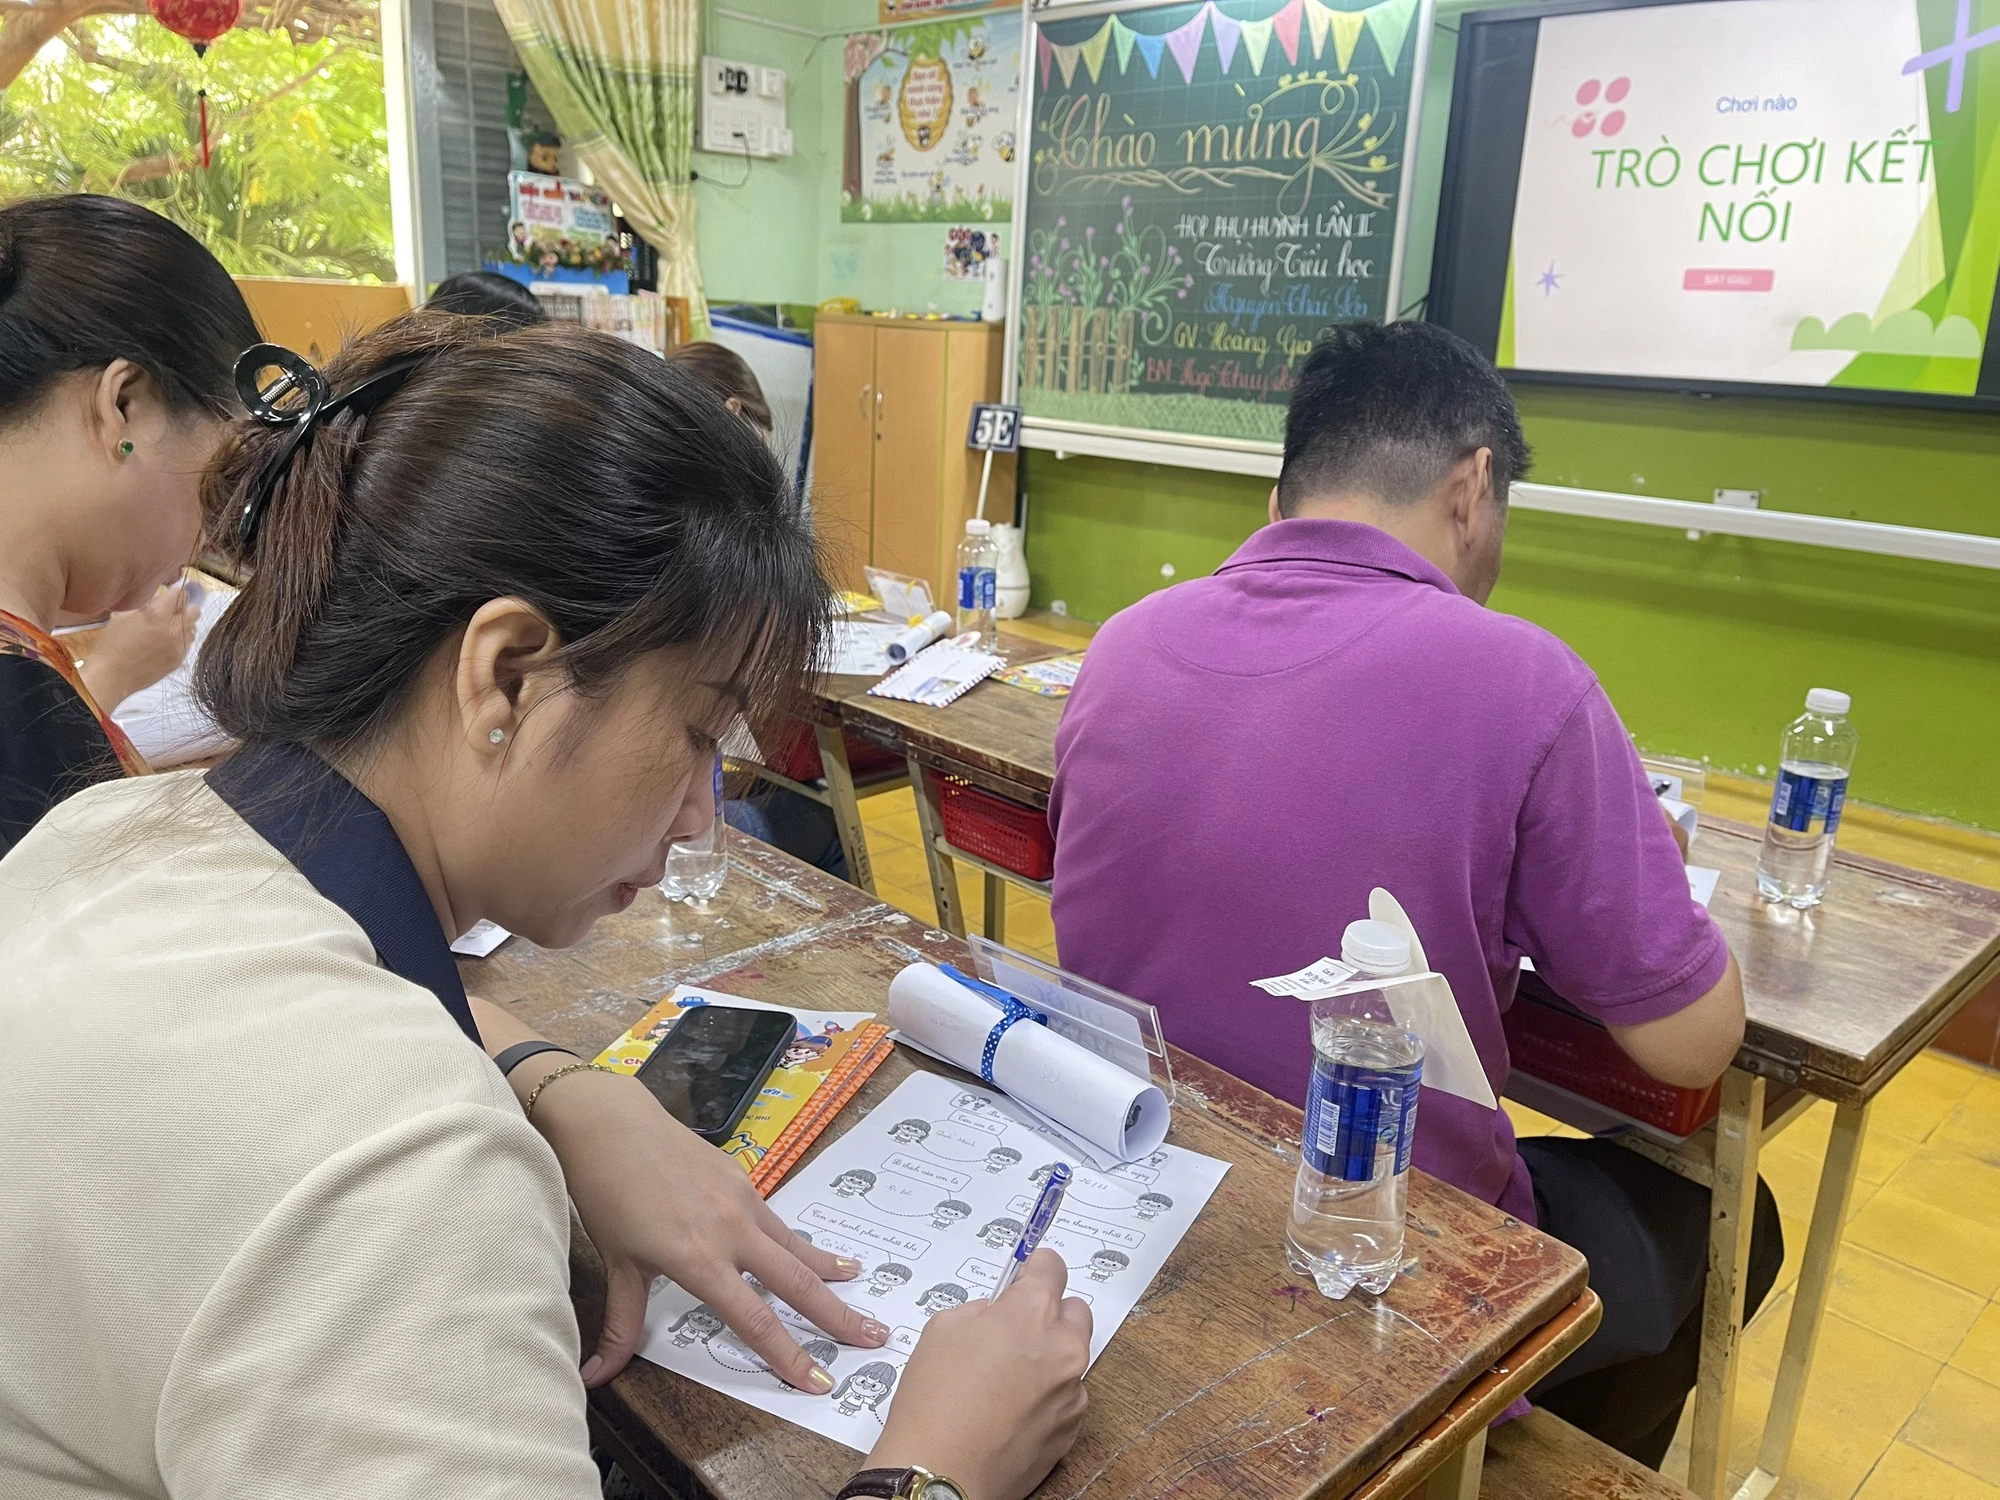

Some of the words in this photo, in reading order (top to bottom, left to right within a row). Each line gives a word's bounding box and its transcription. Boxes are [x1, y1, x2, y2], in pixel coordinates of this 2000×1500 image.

[1716, 95, 1760, 114] Chơi
[1763, 93, 1798, 112] nào
[1045, 91, 1157, 169] Chào
[1176, 83, 1320, 217] mừng
[1591, 134, 1682, 189] TRÒ
[1697, 137, 1826, 186] CHƠI
[1845, 124, 1945, 185] KẾT
[1174, 213, 1209, 243] HỌP
[1213, 214, 1249, 246] PHỤ
[1249, 214, 1309, 239] HUYNH
[1315, 199, 1353, 239] LẦN
[1697, 186, 1792, 243] NỐI
[1193, 240, 1279, 297] Trường
[1275, 241, 1329, 277] Tiểu
[1337, 239, 1375, 285] học
[975, 409, 1015, 446] 5E
[970, 1264, 987, 1277] Con
[793, 1313, 803, 1321] là
[896, 1333, 912, 1346] Ba
